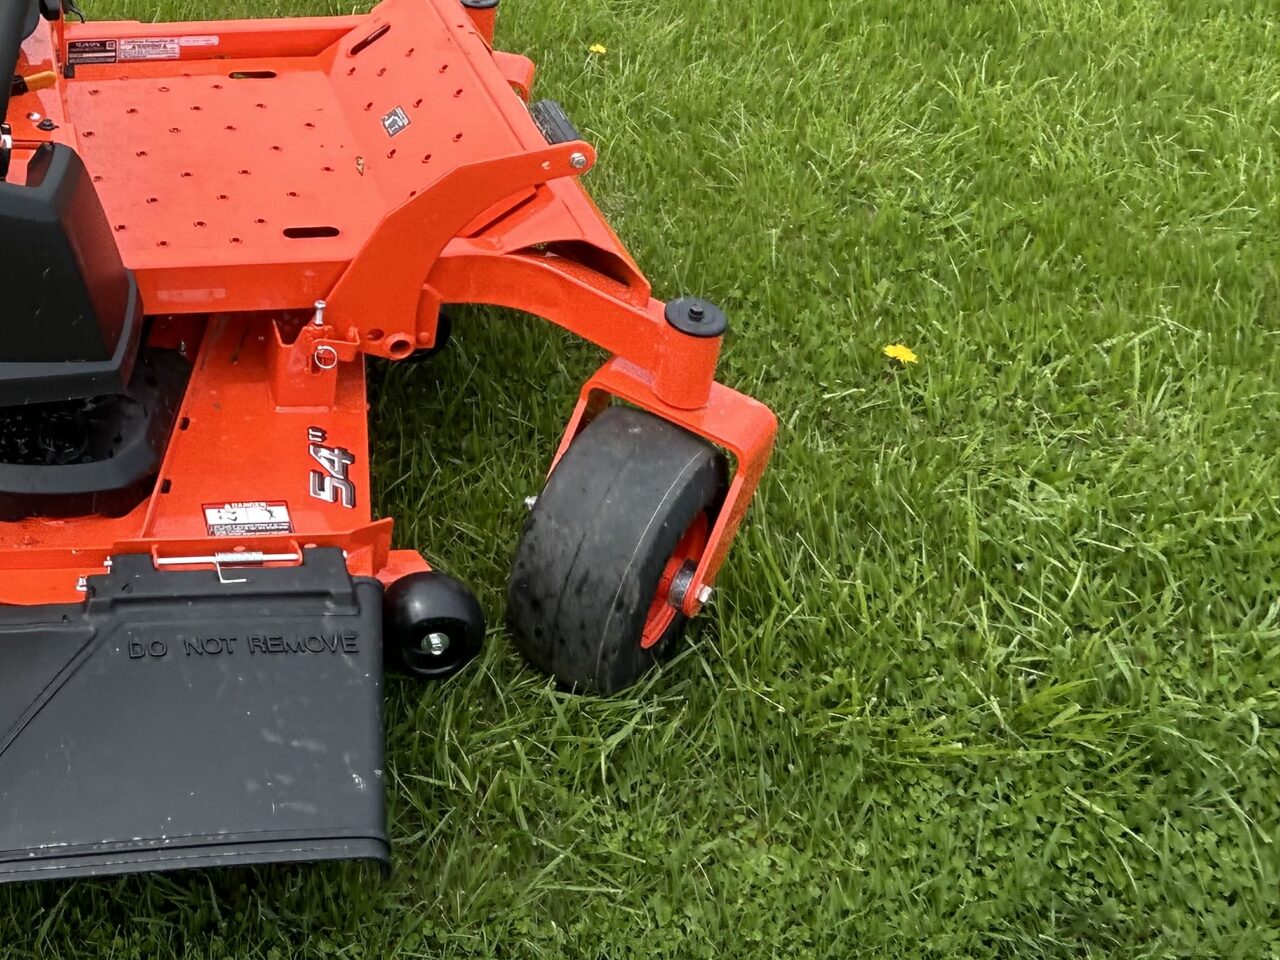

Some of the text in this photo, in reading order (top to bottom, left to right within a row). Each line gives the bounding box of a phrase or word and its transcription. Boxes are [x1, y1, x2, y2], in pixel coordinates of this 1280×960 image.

[307, 426, 356, 509] 54"
[128, 631, 361, 659] DO NOT REMOVE
